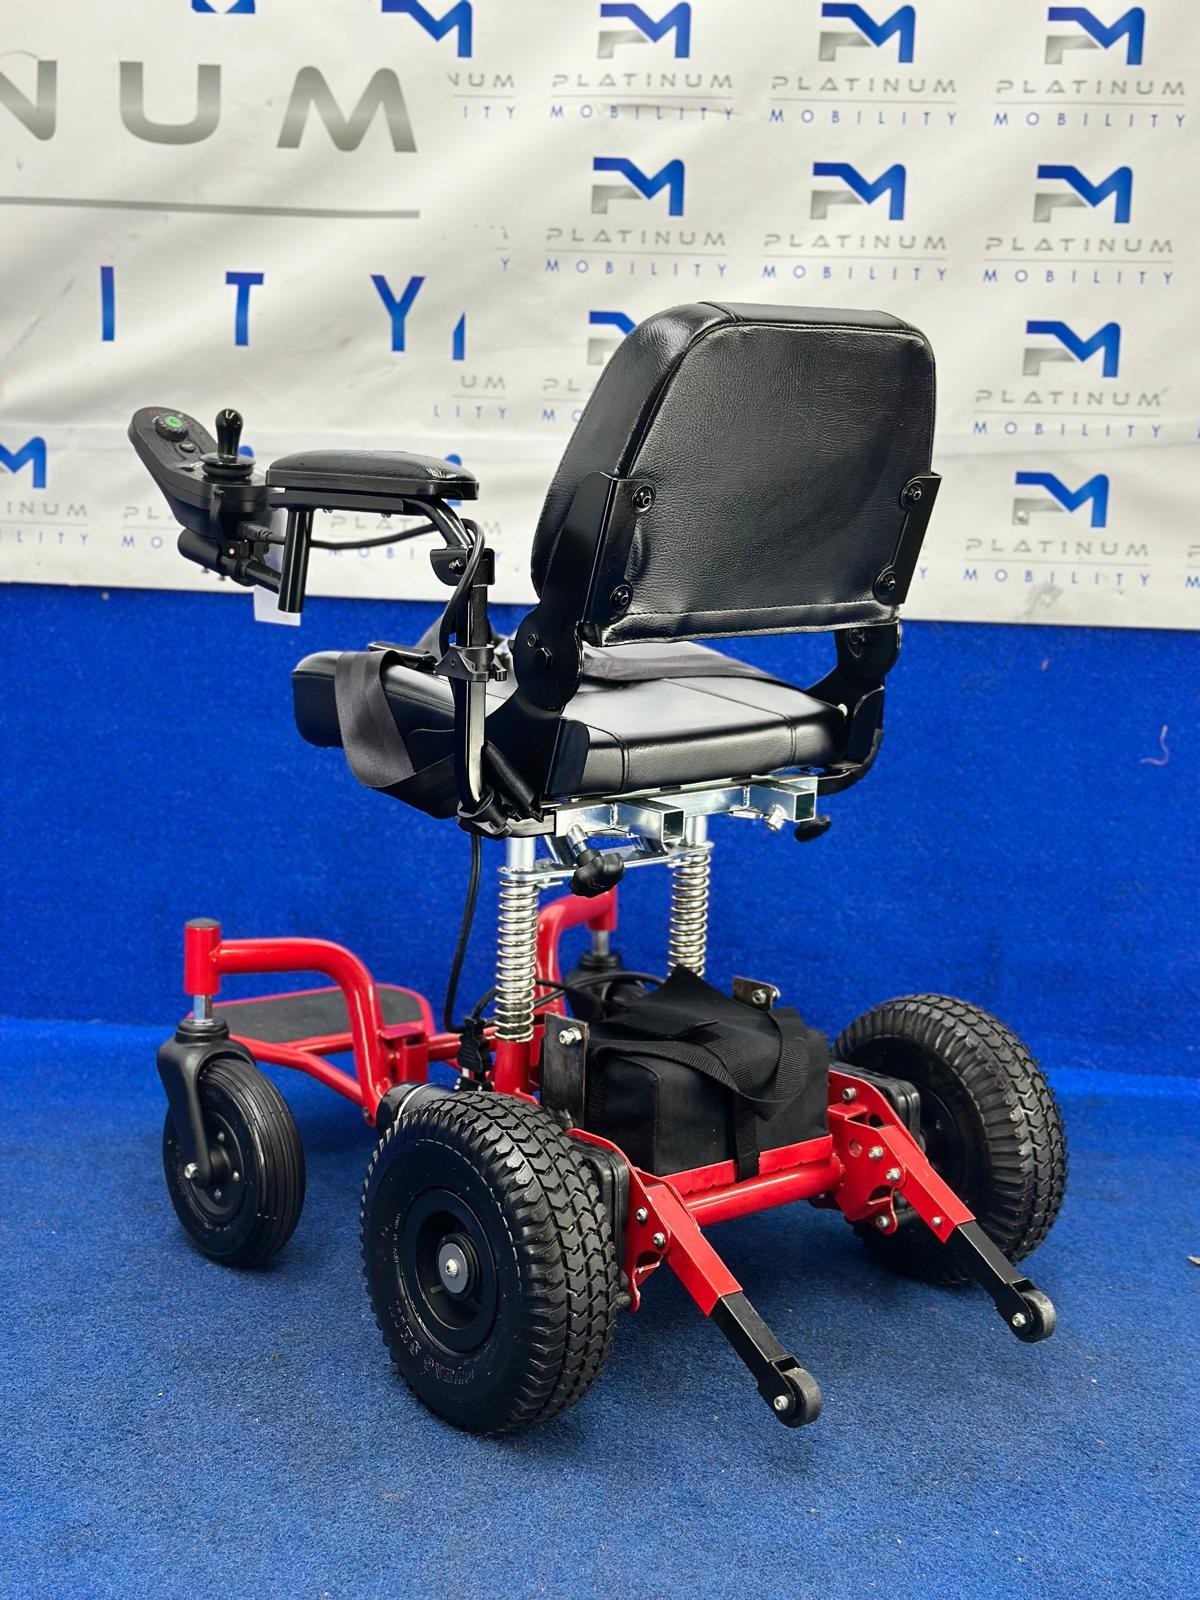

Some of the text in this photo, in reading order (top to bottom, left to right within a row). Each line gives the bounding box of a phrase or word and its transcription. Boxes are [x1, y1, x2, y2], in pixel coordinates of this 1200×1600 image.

[552, 73, 733, 89] PLATINUM
[772, 76, 957, 94] PLATINUM
[996, 80, 1185, 96] PLATINUM
[550, 104, 733, 121] MOBILITY
[769, 109, 957, 126] MOBILITY
[994, 112, 1185, 128] MOBILITY
[546, 228, 726, 246] PLATINUM
[763, 233, 947, 250] PLATINUM
[985, 237, 1173, 254] PLATINUM
[545, 259, 727, 277] MOBILITY
[761, 265, 947, 282] MOBILITY
[982, 269, 1174, 286] MOBILITY
[974, 389, 1161, 408] PLATINUM
[972, 421, 1162, 438] MOBILITY
[965, 538, 1149, 558] PLATINUM
[963, 568, 1150, 585] MOBILITY
